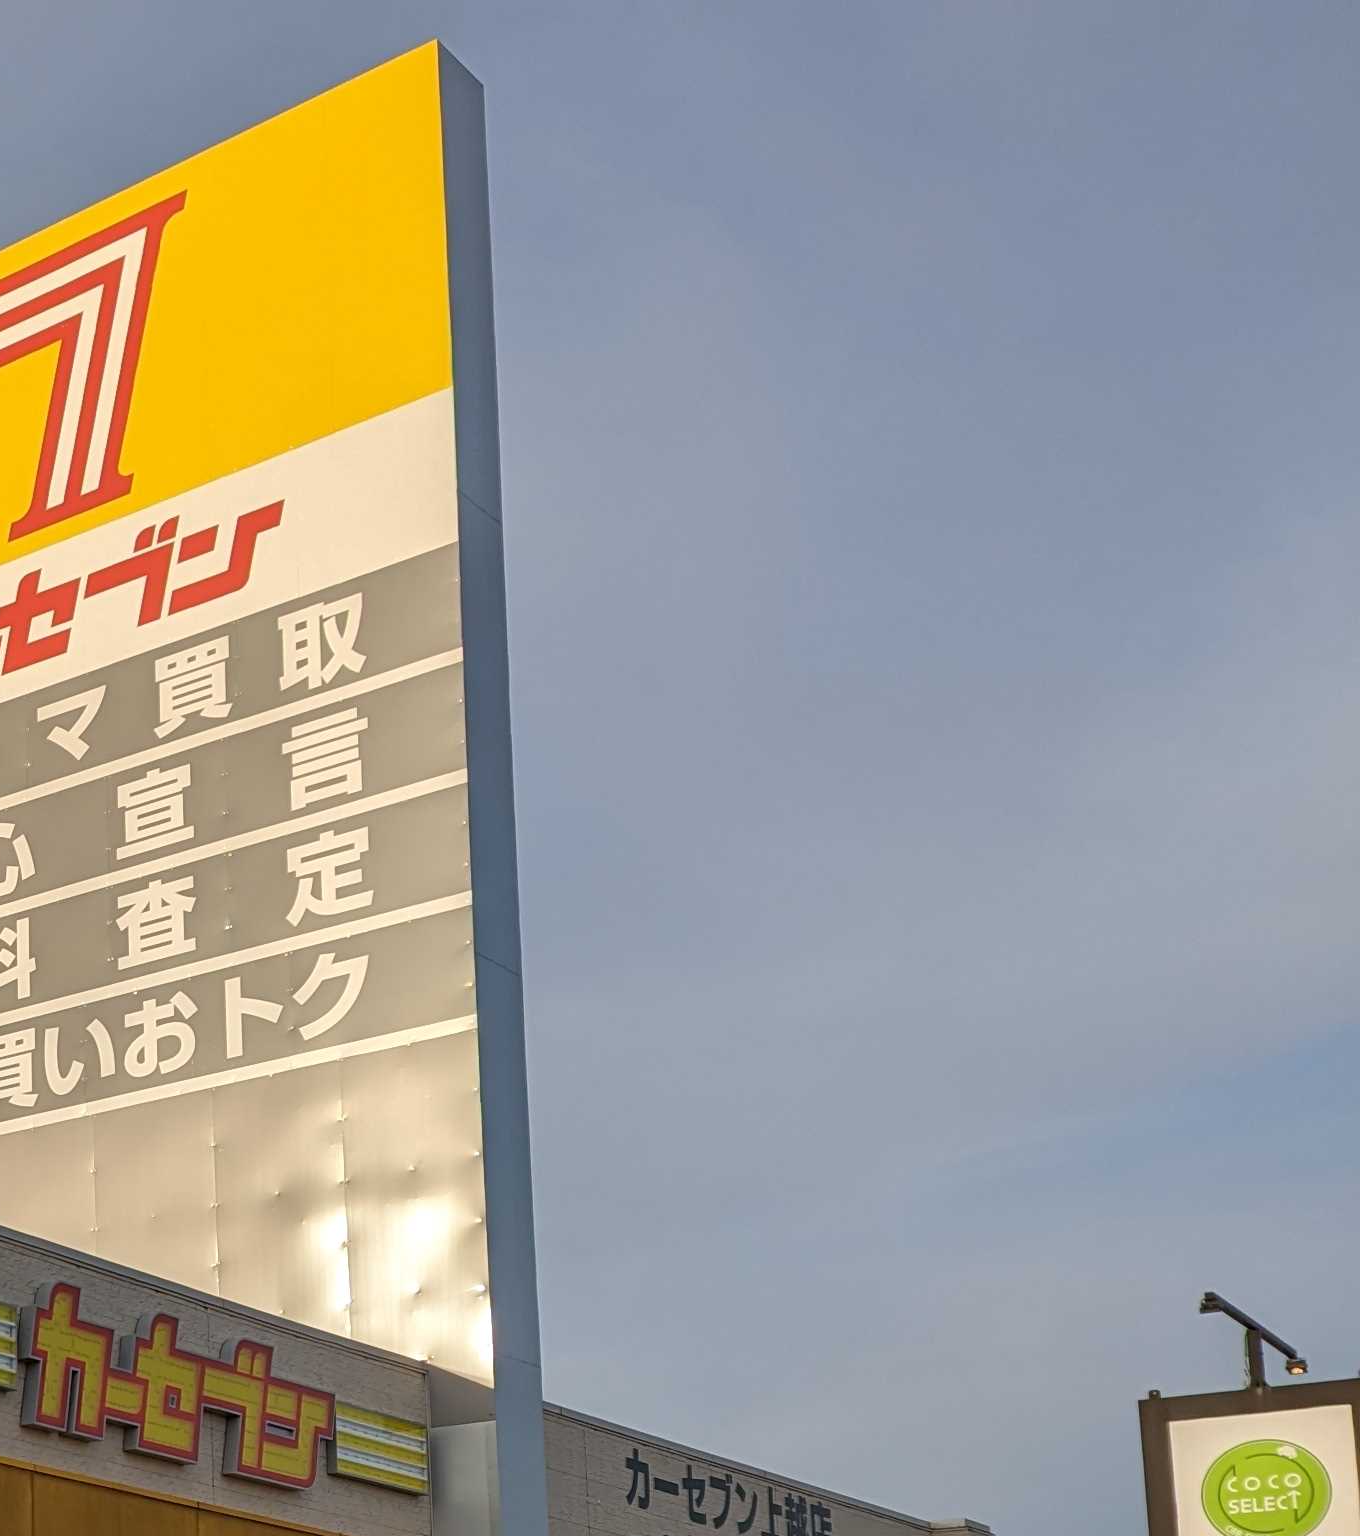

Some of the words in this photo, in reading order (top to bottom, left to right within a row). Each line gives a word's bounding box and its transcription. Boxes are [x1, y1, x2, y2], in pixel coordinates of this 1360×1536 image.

[22, 1282, 335, 1489] カーセブン
[1226, 1472, 1303, 1493] COCO
[1228, 1489, 1302, 1515] SELECT
